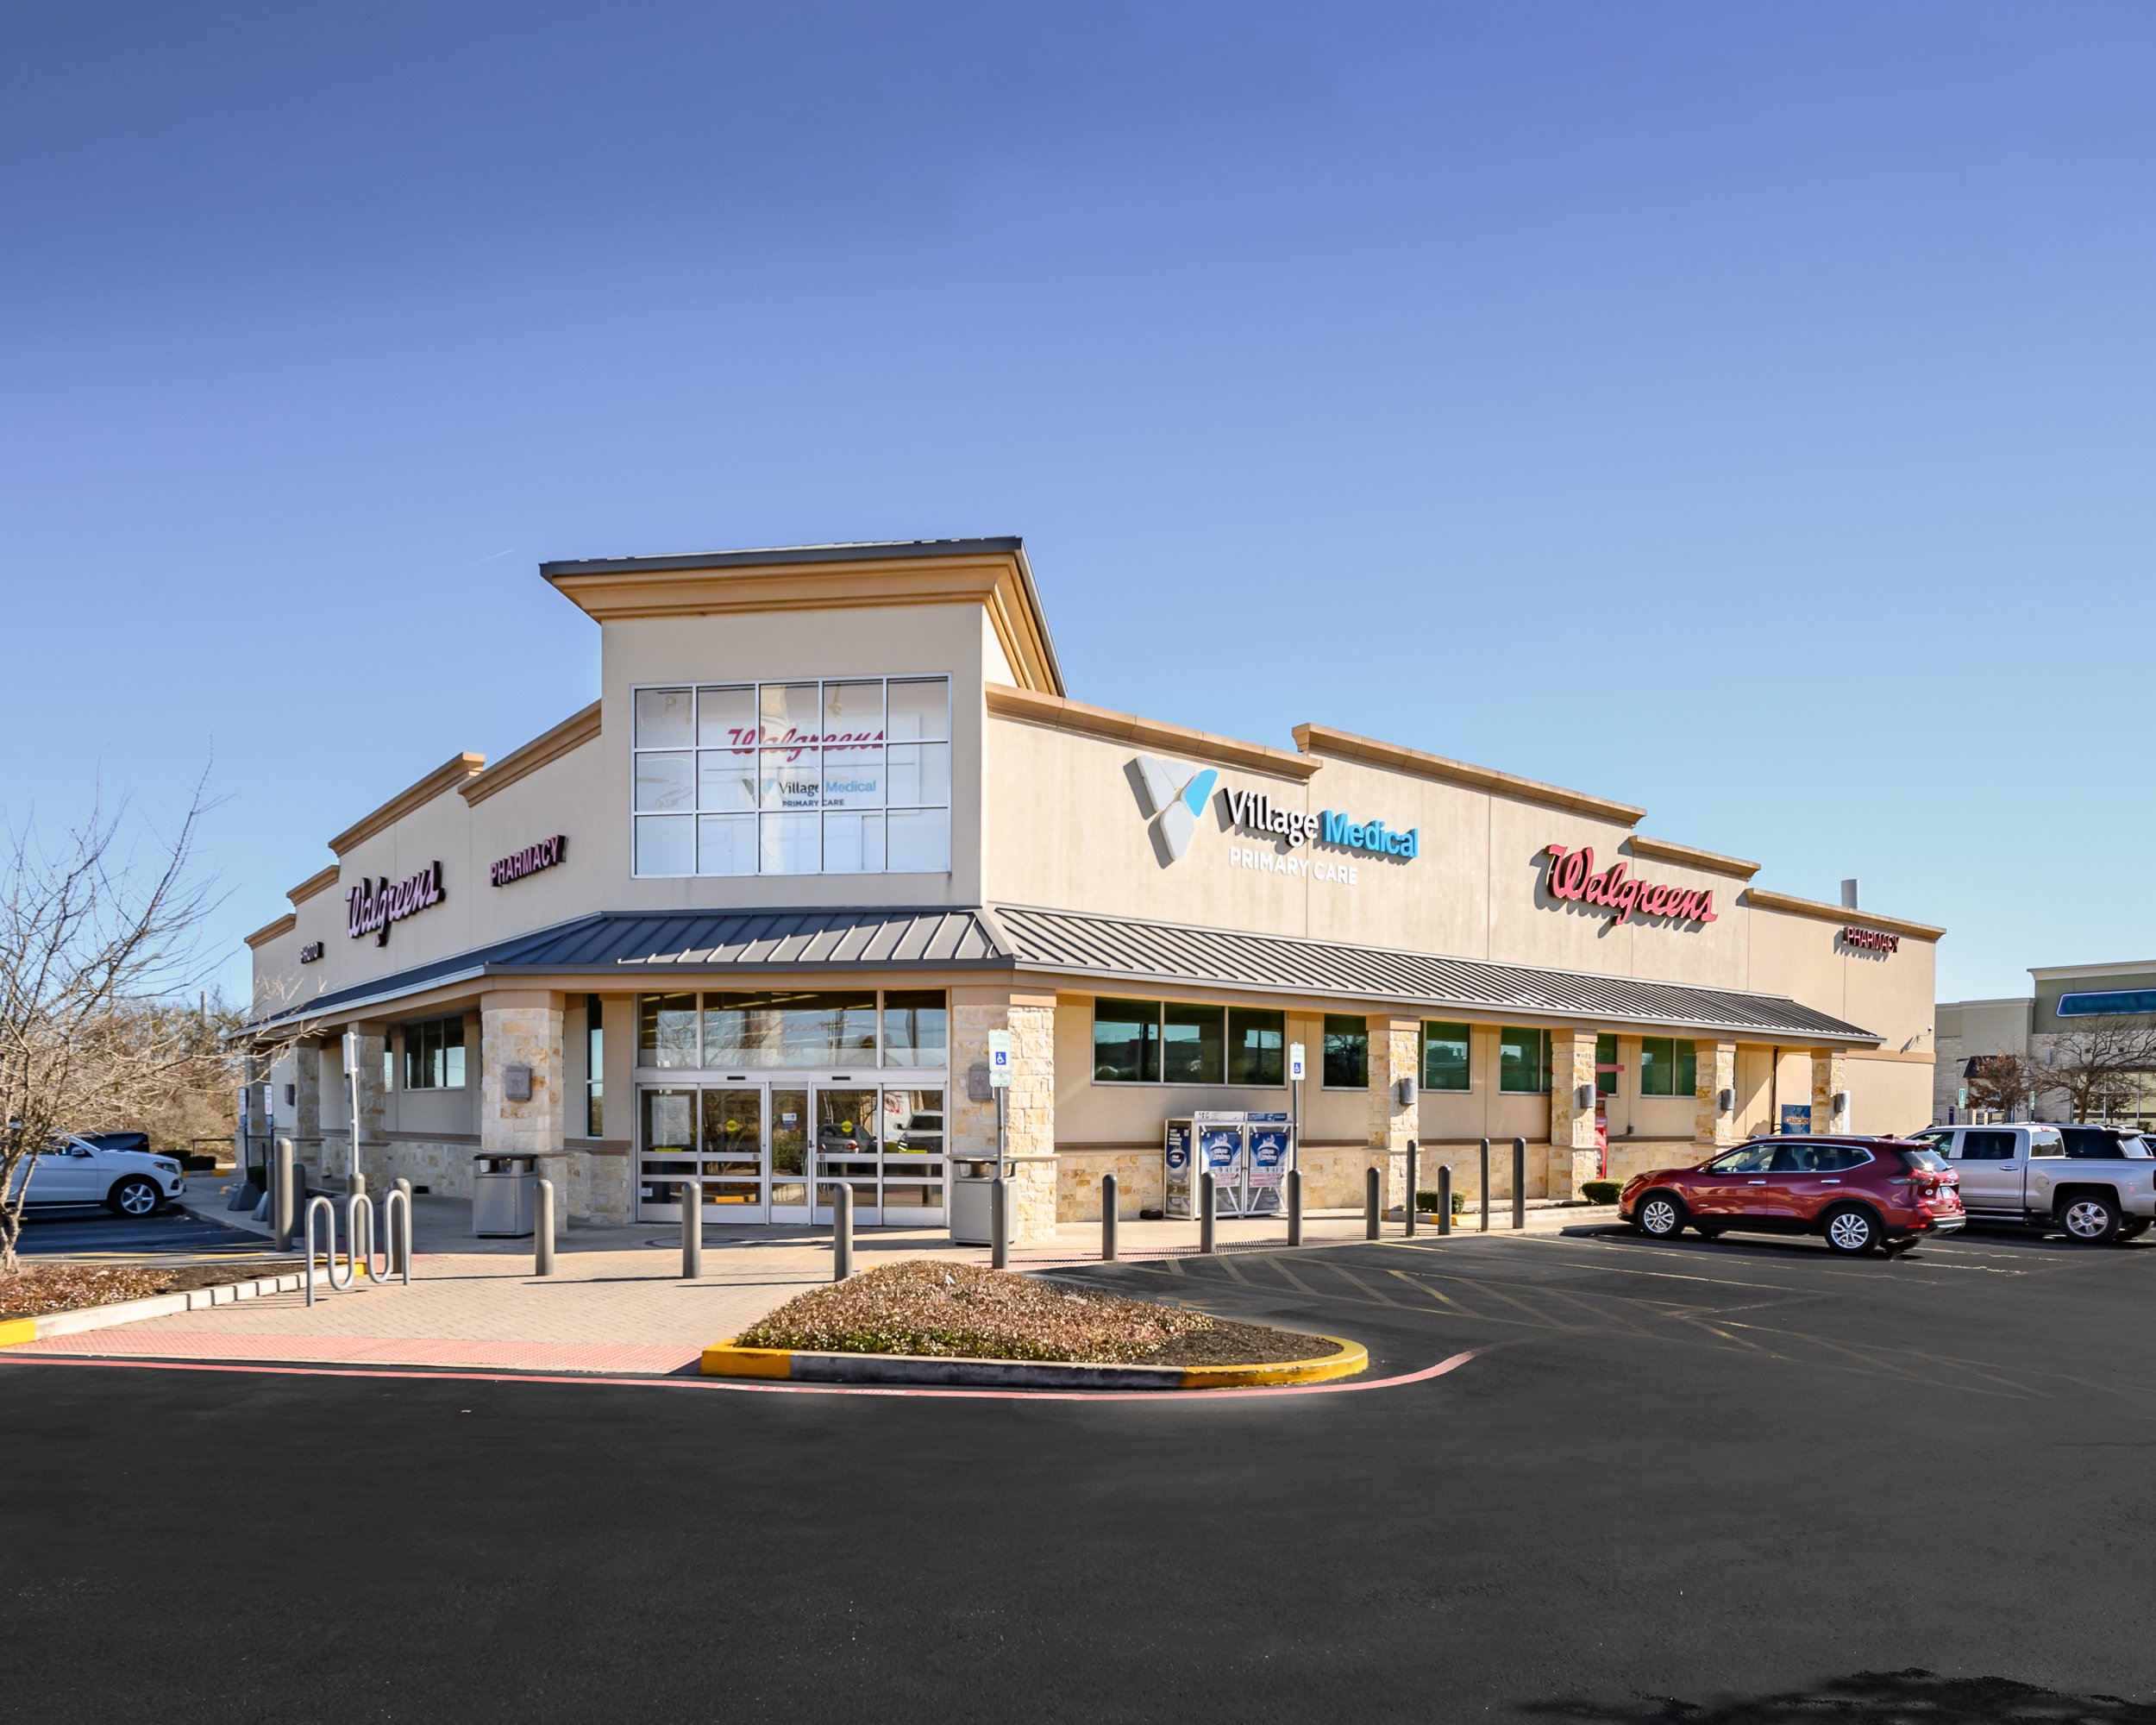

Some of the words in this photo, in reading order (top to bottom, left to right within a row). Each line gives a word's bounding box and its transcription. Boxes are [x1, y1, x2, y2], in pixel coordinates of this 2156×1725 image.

[728, 728, 883, 762] Walgreens
[825, 780, 876, 793] Medical
[1224, 787, 1319, 848] Village
[1323, 809, 1419, 857] Medical
[491, 835, 567, 887] PHARMACY
[1229, 848, 1308, 877] PRIMARY
[1313, 862, 1358, 885] CARE
[345, 861, 445, 948] Walgreens
[1548, 844, 1719, 926] Walgreens
[1846, 927, 1900, 953] PHARMACY
